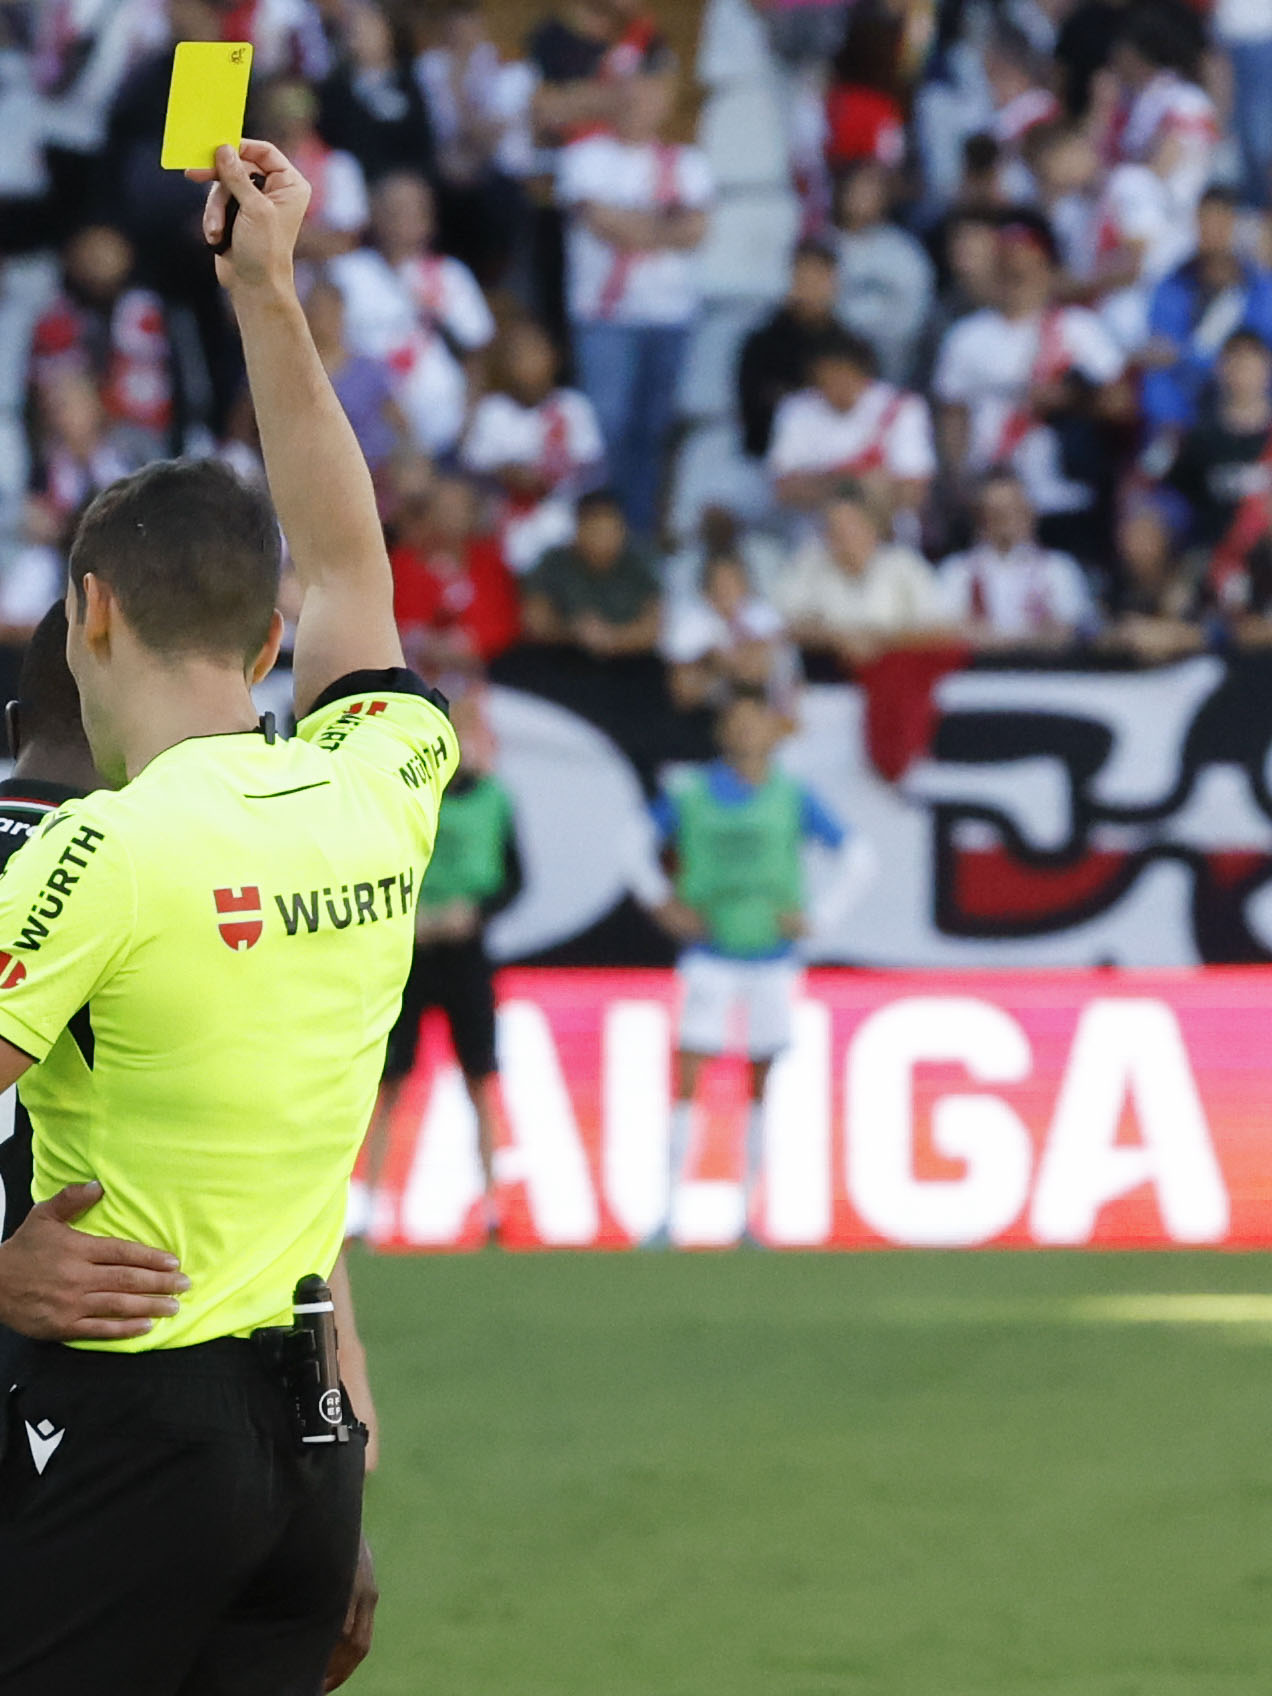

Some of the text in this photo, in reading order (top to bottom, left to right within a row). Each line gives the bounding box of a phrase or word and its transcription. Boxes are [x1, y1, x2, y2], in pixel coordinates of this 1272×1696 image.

[13, 825, 105, 951] WÜRTH
[274, 866, 414, 936] WÜRTH
[368, 998, 1230, 1247] ALIGA
